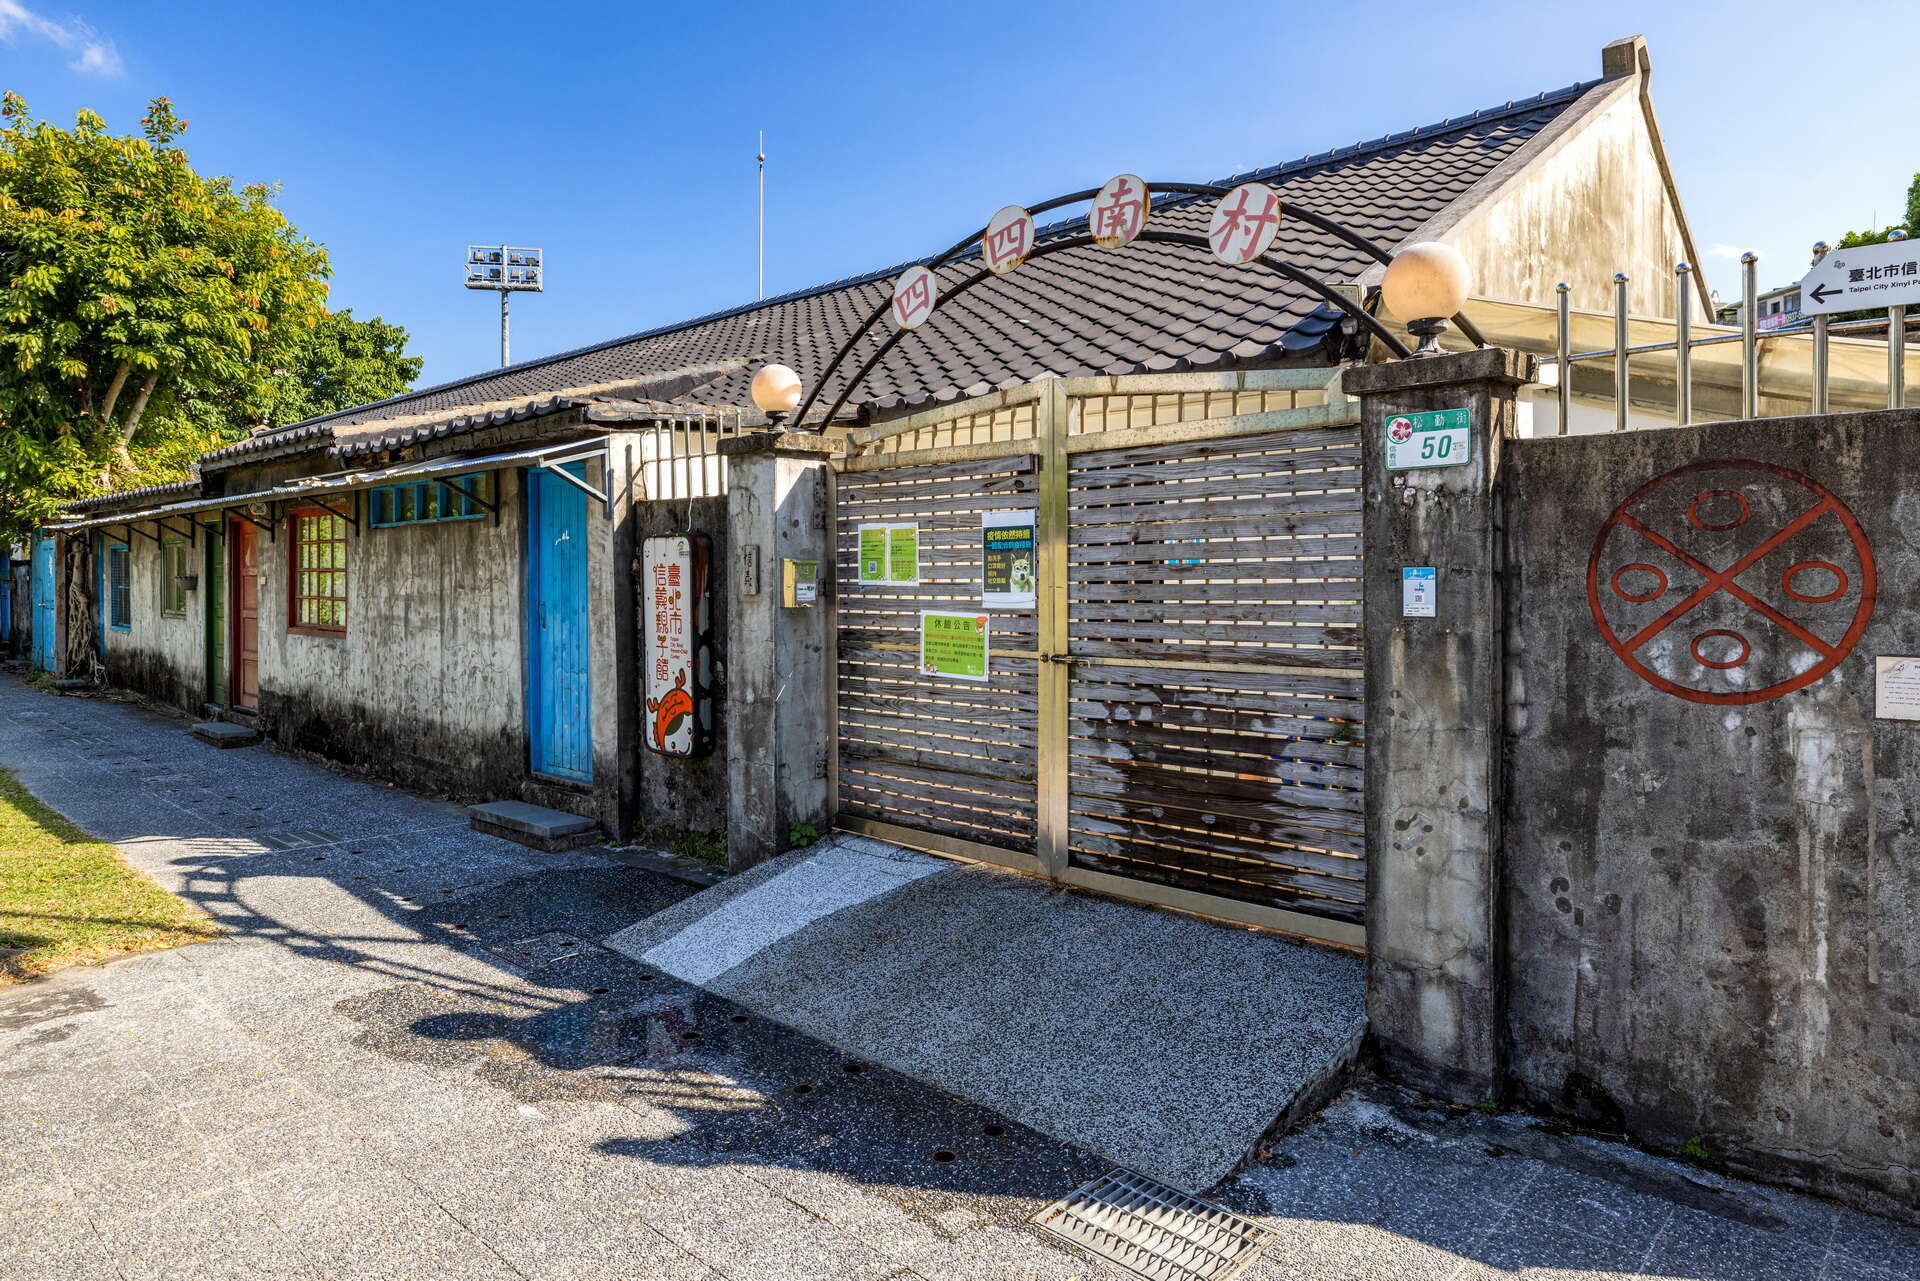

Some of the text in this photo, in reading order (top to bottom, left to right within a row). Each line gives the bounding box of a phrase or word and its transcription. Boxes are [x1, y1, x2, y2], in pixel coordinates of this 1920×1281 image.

[1848, 261, 1920, 283] 臺北市信
[1849, 286, 1872, 294] Taipei
[1890, 279, 1911, 288] Xinyi
[1412, 411, 1467, 429] 松勤街
[1421, 434, 1452, 459] 50
[667, 562, 682, 635] 臺北市
